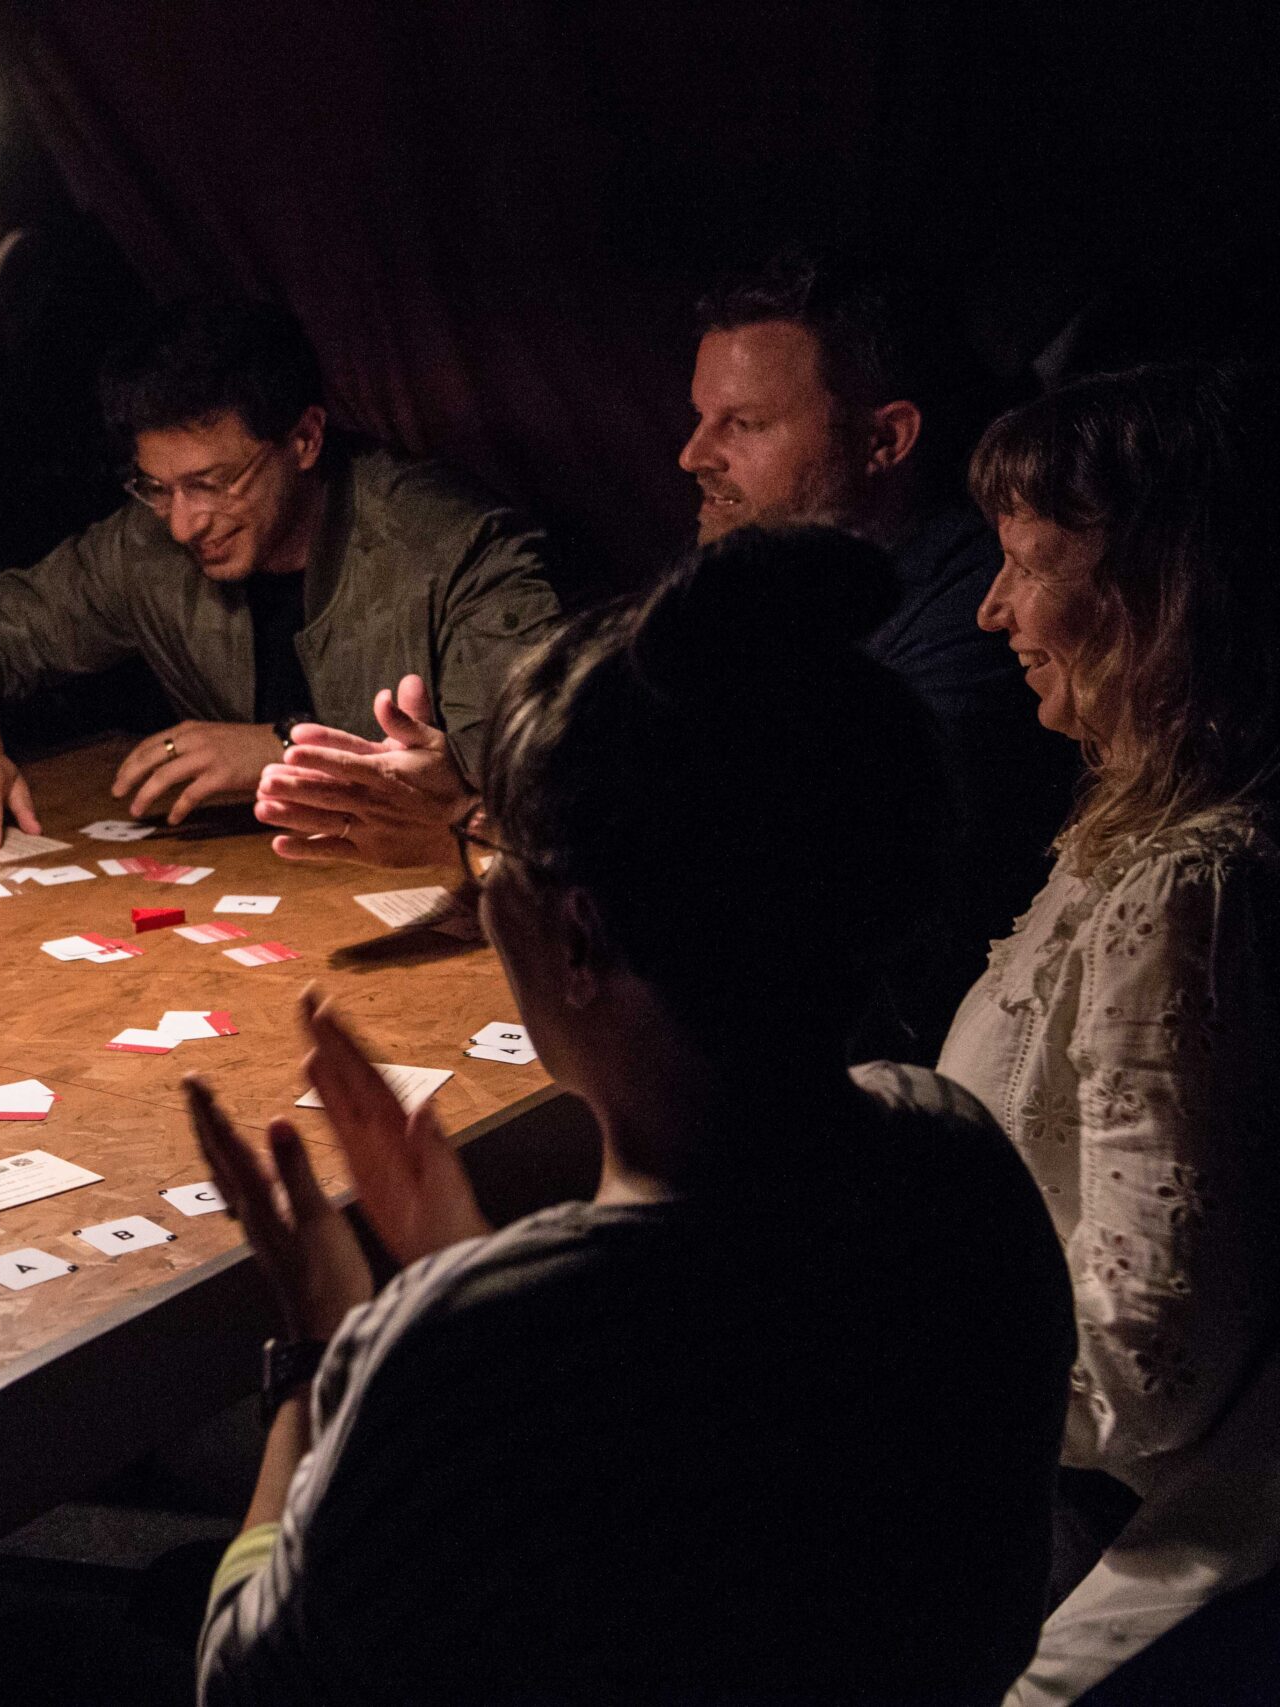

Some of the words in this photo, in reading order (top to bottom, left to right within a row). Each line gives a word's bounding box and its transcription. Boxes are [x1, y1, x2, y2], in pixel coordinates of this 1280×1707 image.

[500, 1032, 522, 1040] B
[194, 1191, 217, 1202] C
[111, 1230, 136, 1241] B
[14, 1263, 39, 1275] A
